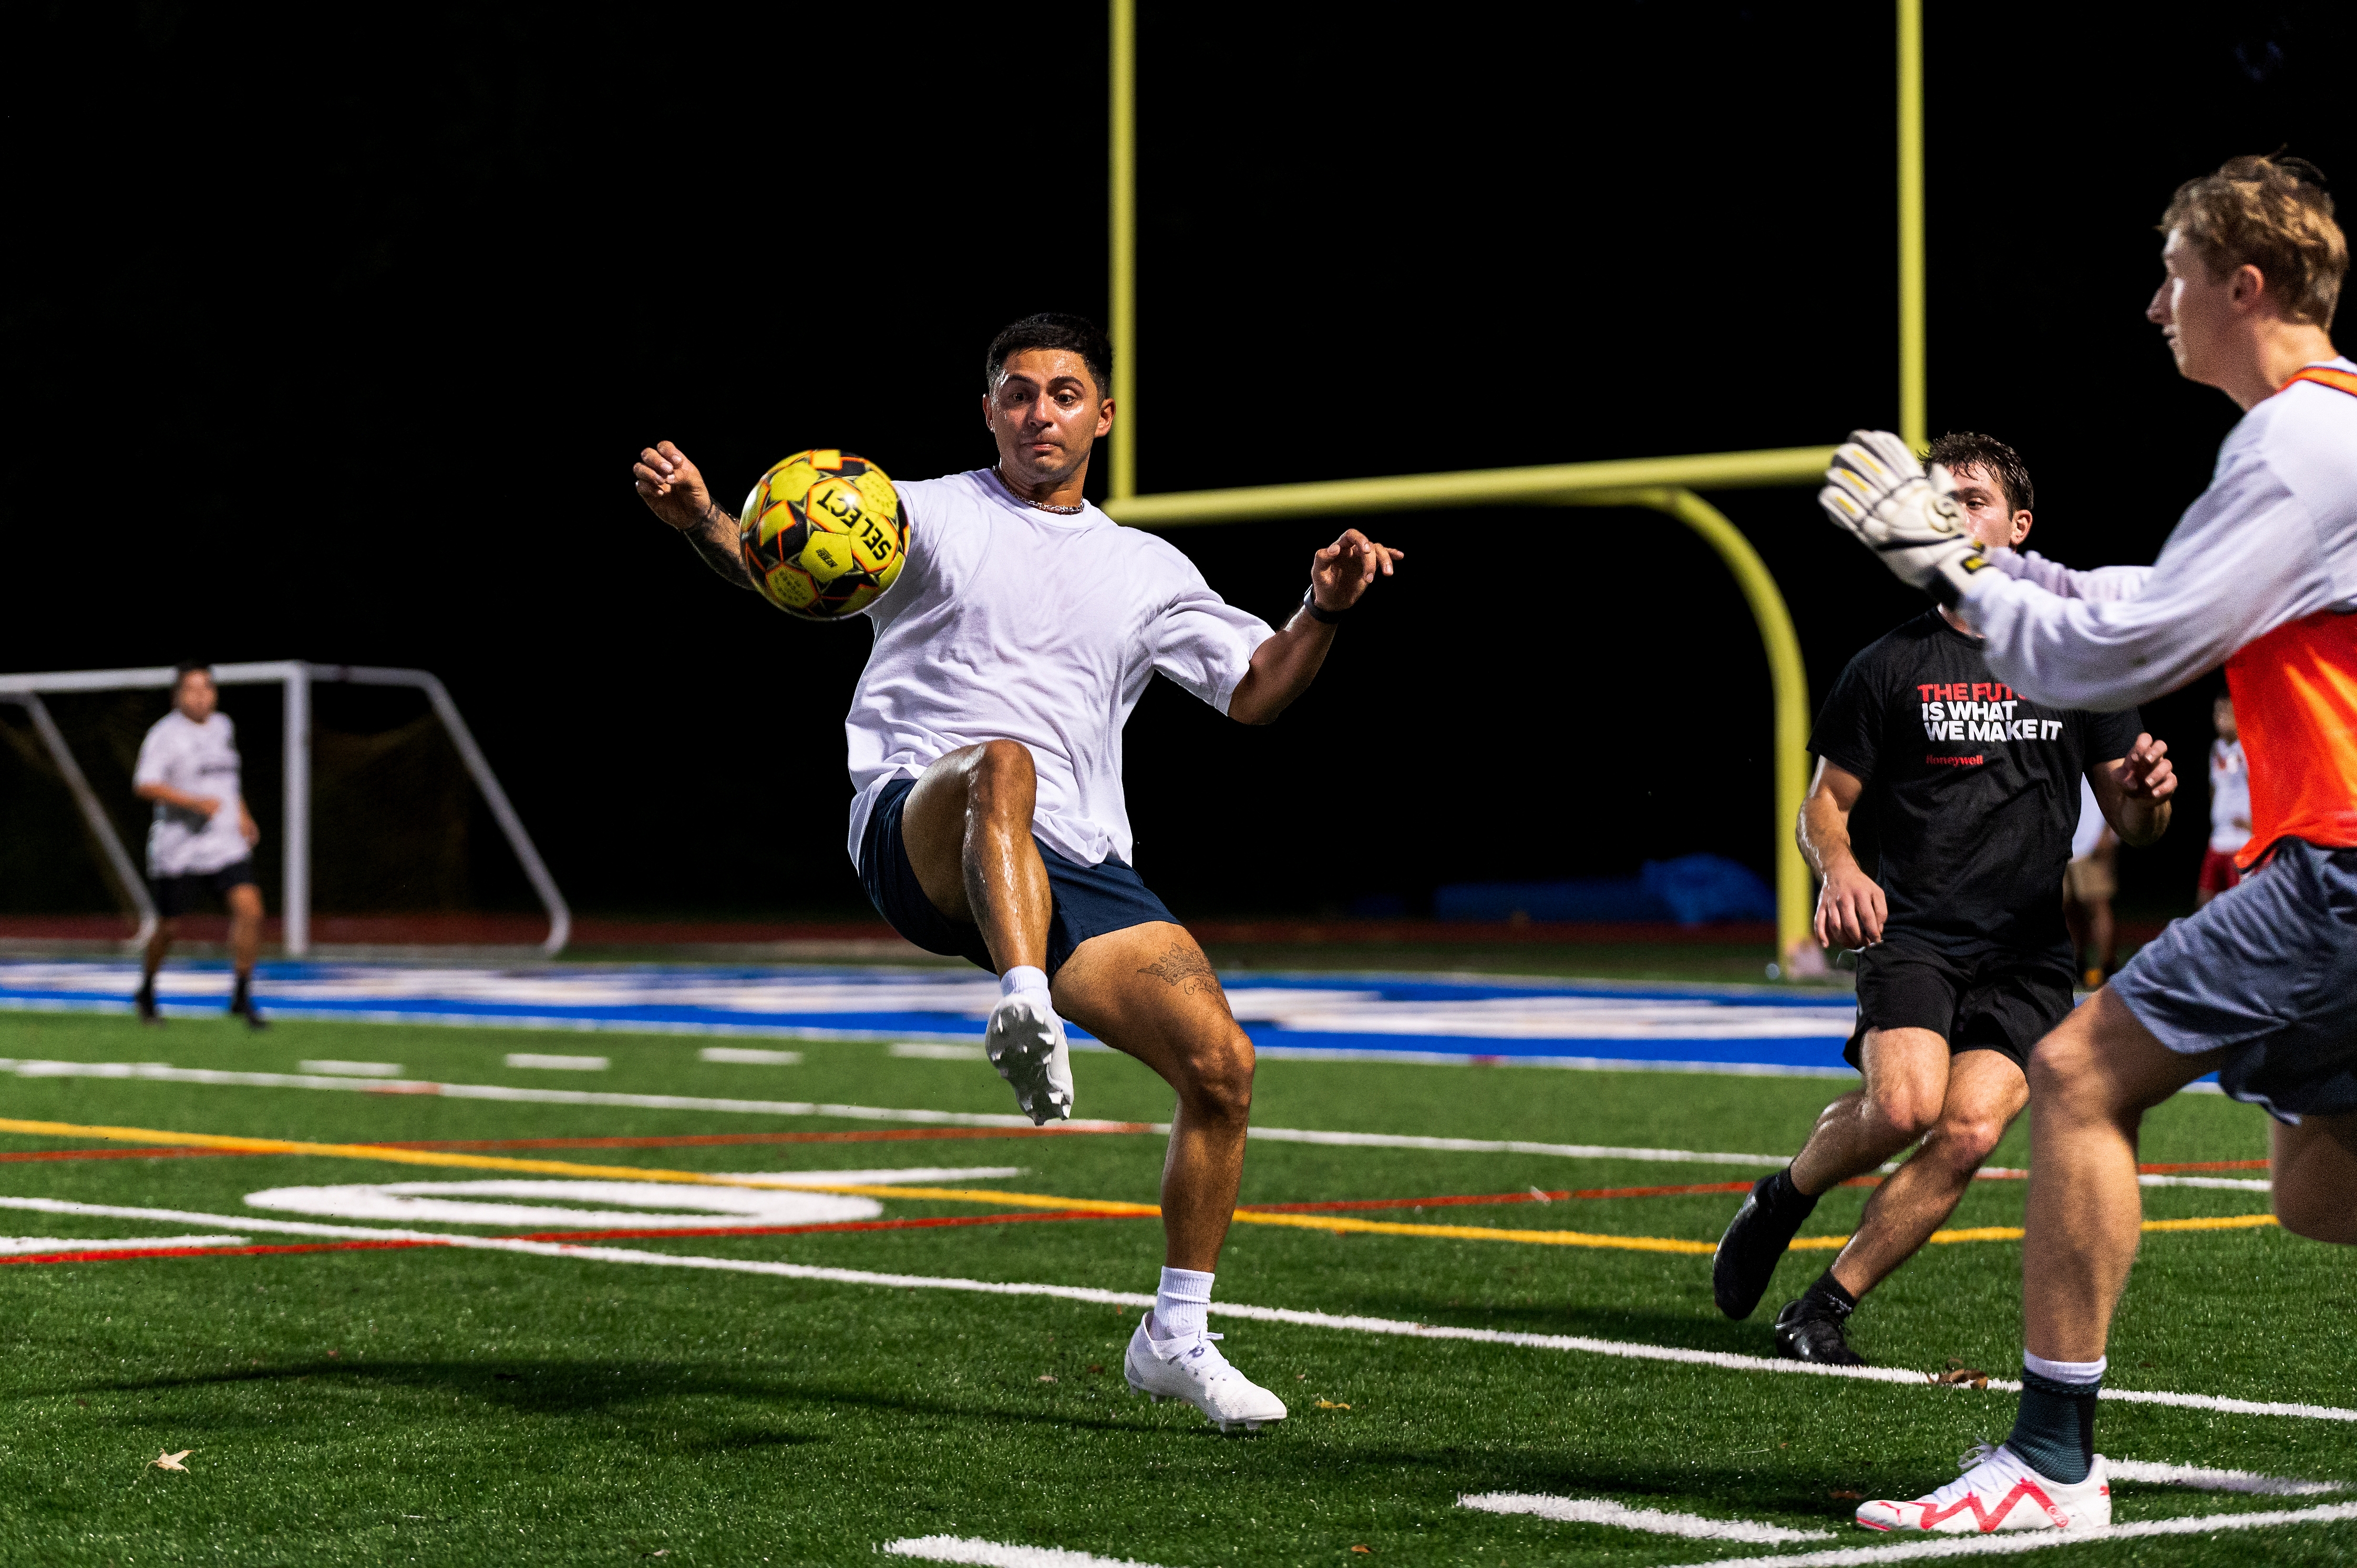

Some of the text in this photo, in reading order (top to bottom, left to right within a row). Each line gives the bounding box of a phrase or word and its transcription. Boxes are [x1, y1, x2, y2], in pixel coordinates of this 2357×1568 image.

[816, 489, 892, 561] SELECT
[1917, 683, 2028, 703] THE FUT
[1922, 700, 2018, 722] IS WHAT
[1924, 719, 2063, 742] WE MAKE IT
[1926, 754, 1983, 767] Honeywell
